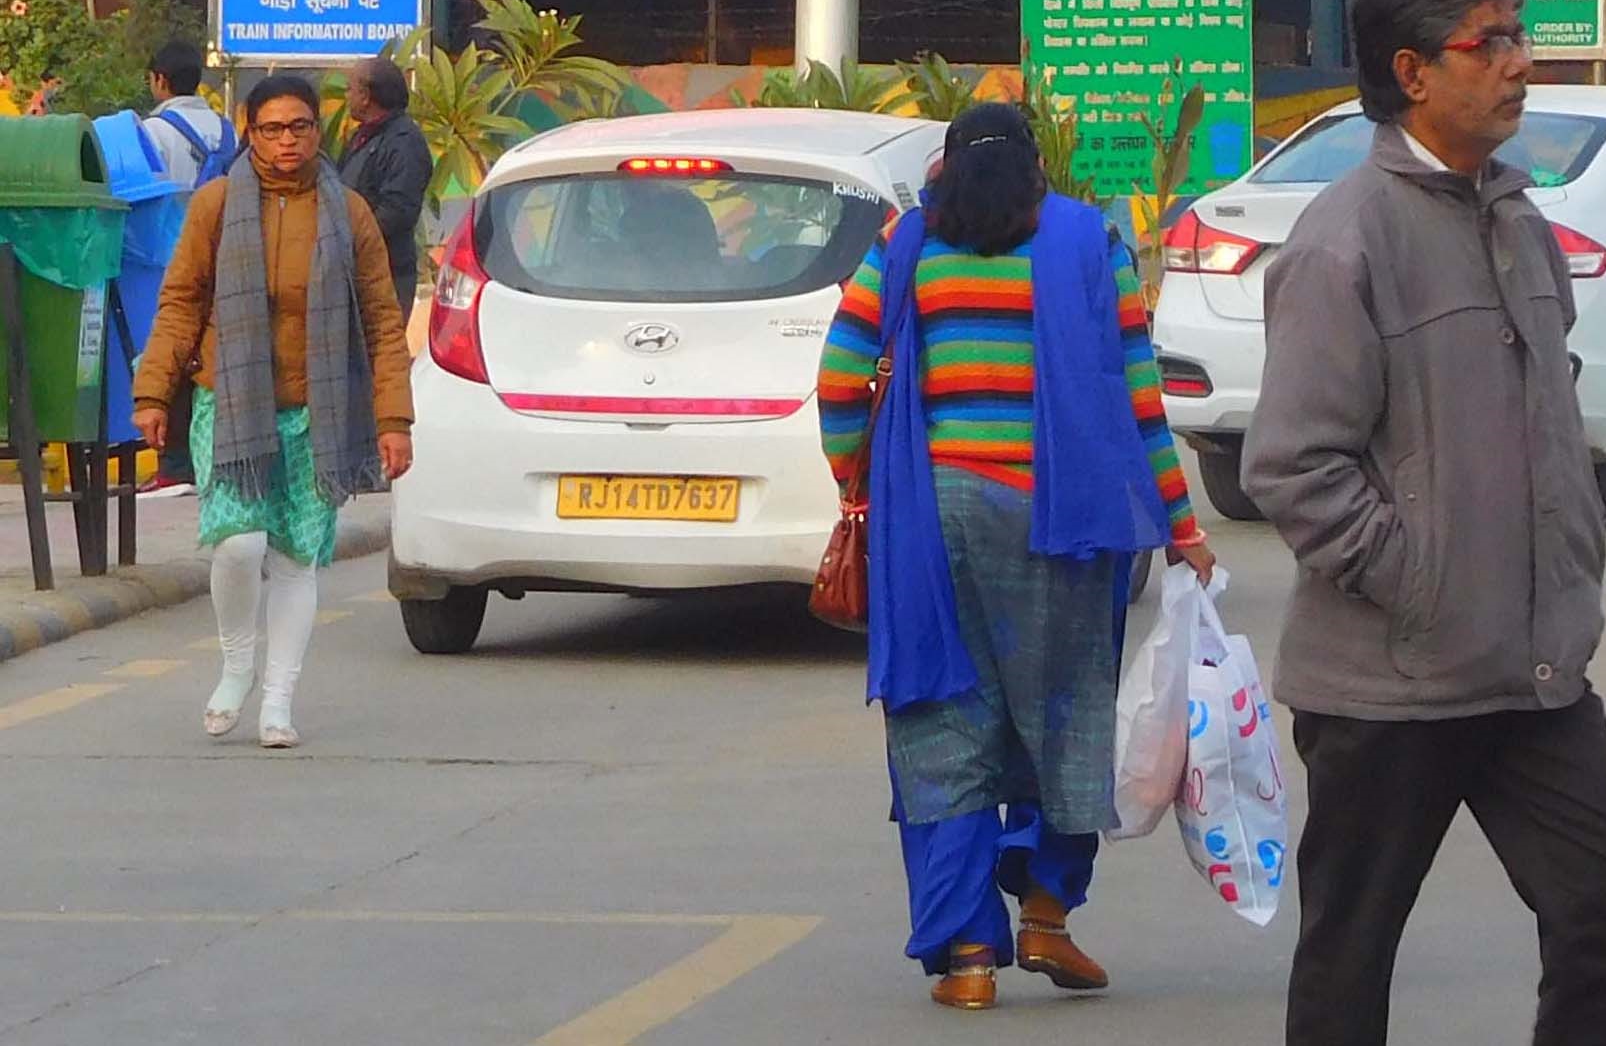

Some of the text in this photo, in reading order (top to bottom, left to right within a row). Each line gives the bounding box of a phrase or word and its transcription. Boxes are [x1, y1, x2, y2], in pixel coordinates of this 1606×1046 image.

[227, 23, 269, 40] TRAIN
[273, 23, 364, 40] INFORMATION
[578, 483, 735, 511] RJ14TD7637
